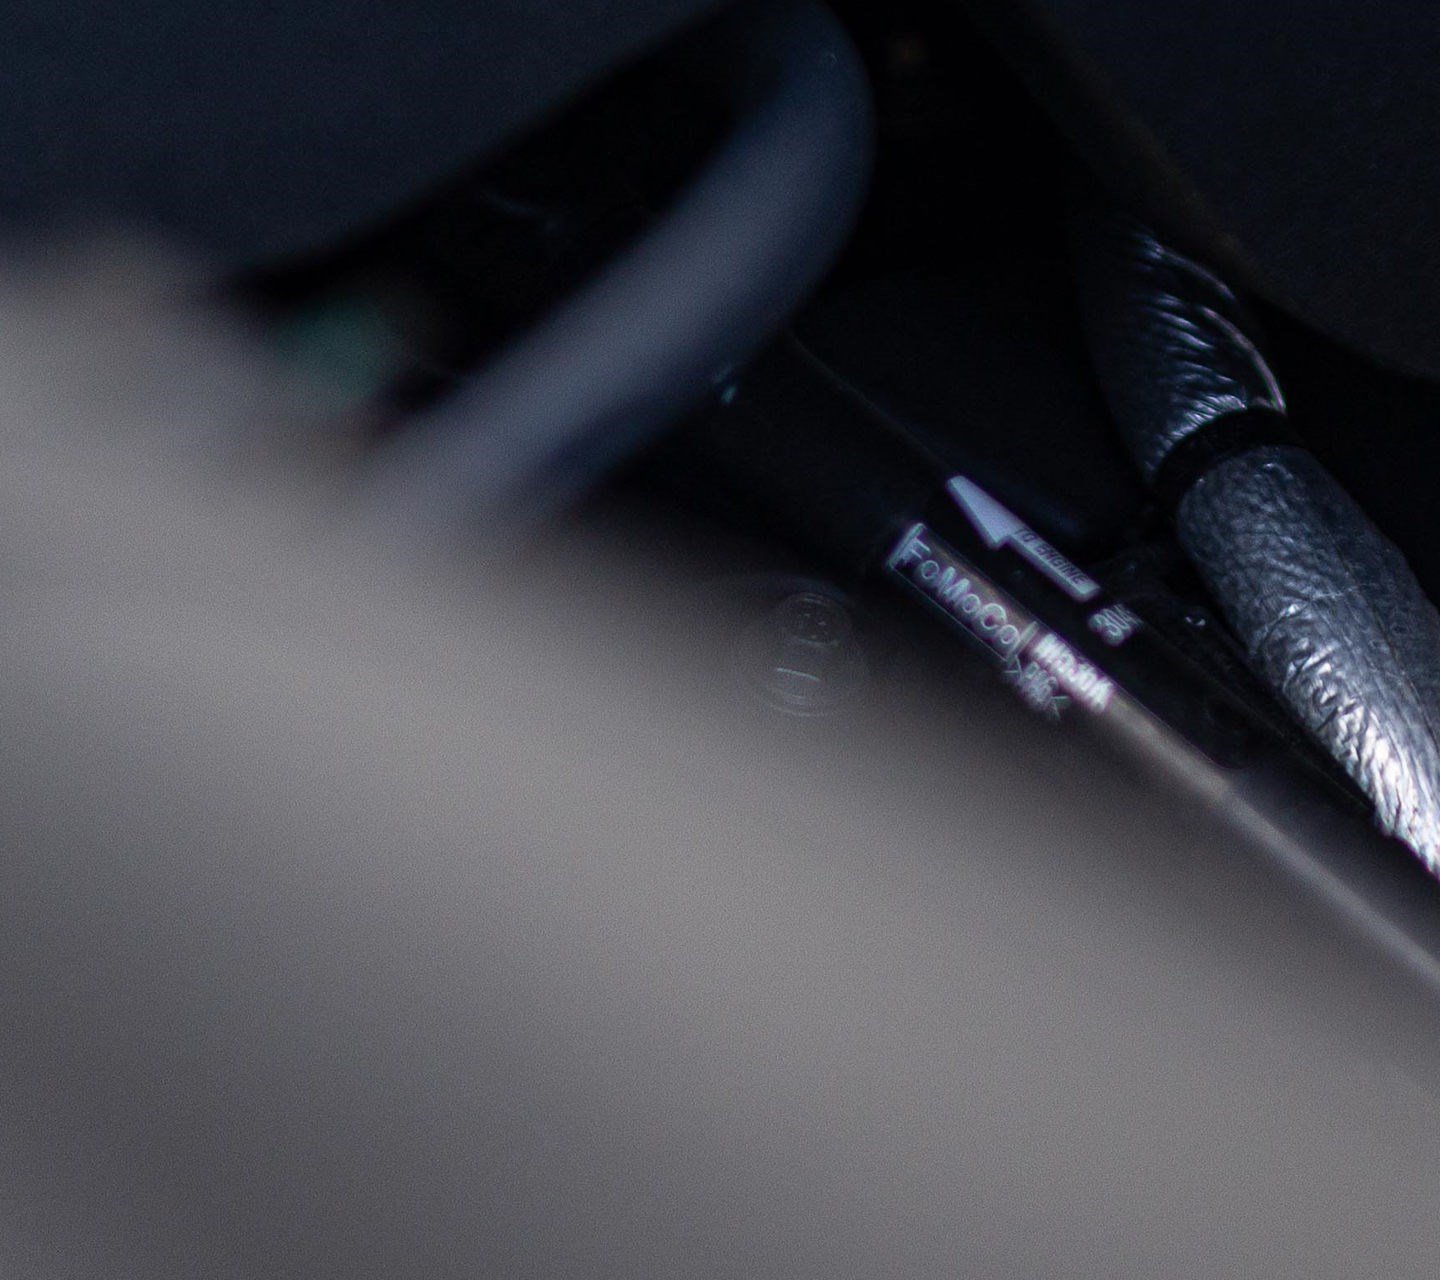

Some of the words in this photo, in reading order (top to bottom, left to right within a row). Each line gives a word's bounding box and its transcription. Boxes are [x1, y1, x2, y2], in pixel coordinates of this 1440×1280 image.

[900, 536, 1020, 648] FoMoCo
[1016, 527, 1036, 544] TO
[1037, 542, 1090, 586] ENGINE
